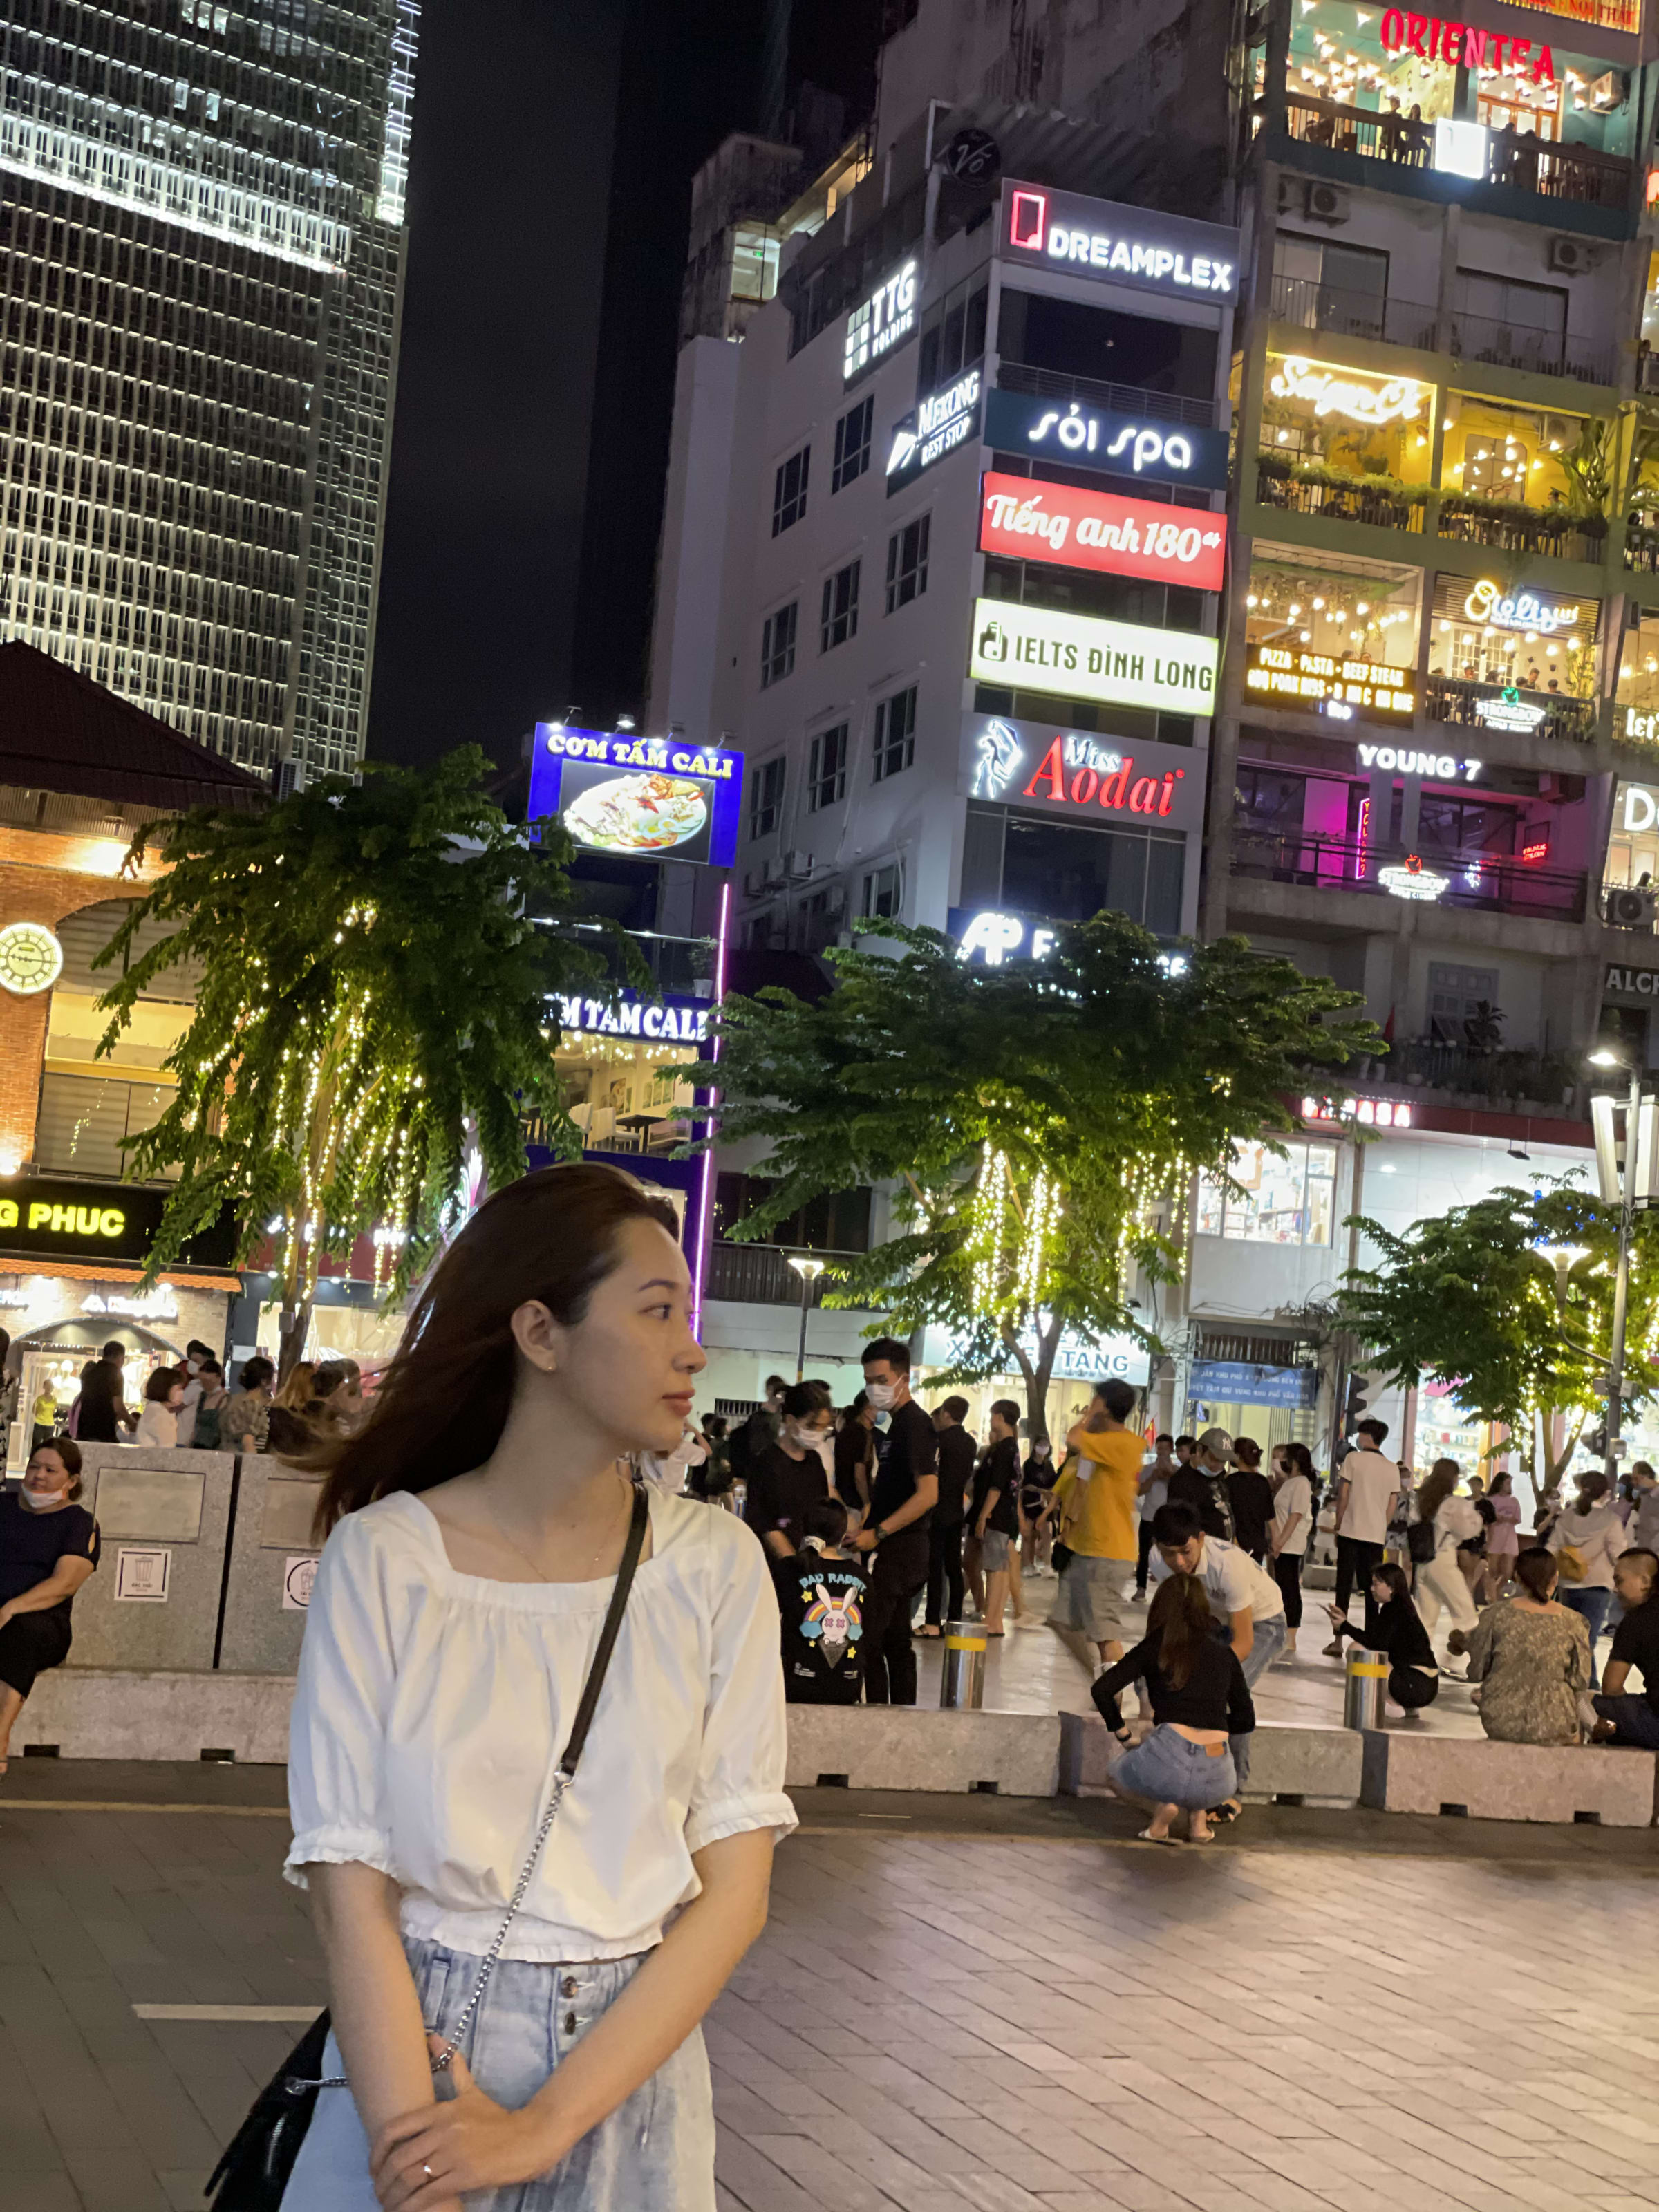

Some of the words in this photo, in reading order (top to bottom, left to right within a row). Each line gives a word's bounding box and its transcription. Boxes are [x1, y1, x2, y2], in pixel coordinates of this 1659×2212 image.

[1380, 8, 1555, 85] ORIENTEA
[1047, 227, 1232, 291] DREAMPLEX
[872, 260, 916, 335] TTG
[872, 309, 913, 357] HOLDING
[921, 431, 945, 467] REST
[945, 415, 971, 453] STOP
[1107, 428, 1192, 472] spa
[986, 494, 1069, 550] Tiếng
[1015, 635, 1078, 671] IELTS
[1087, 645, 1144, 682] ĐÌNH
[1154, 658, 1212, 692] LONG
[1259, 647, 1292, 670] PIZZA
[1300, 654, 1334, 677] PASTA
[547, 733, 608, 760] CƠM
[613, 738, 668, 769] TẤM
[672, 752, 733, 780] CALI
[1022, 735, 1175, 818] Aodai
[1358, 744, 1457, 778] YOUNG
[1464, 759, 1481, 780] 7
[1624, 788, 1659, 831] D
[28, 1203, 125, 1237] PHUC
[1061, 1349, 1129, 1373] TANG
